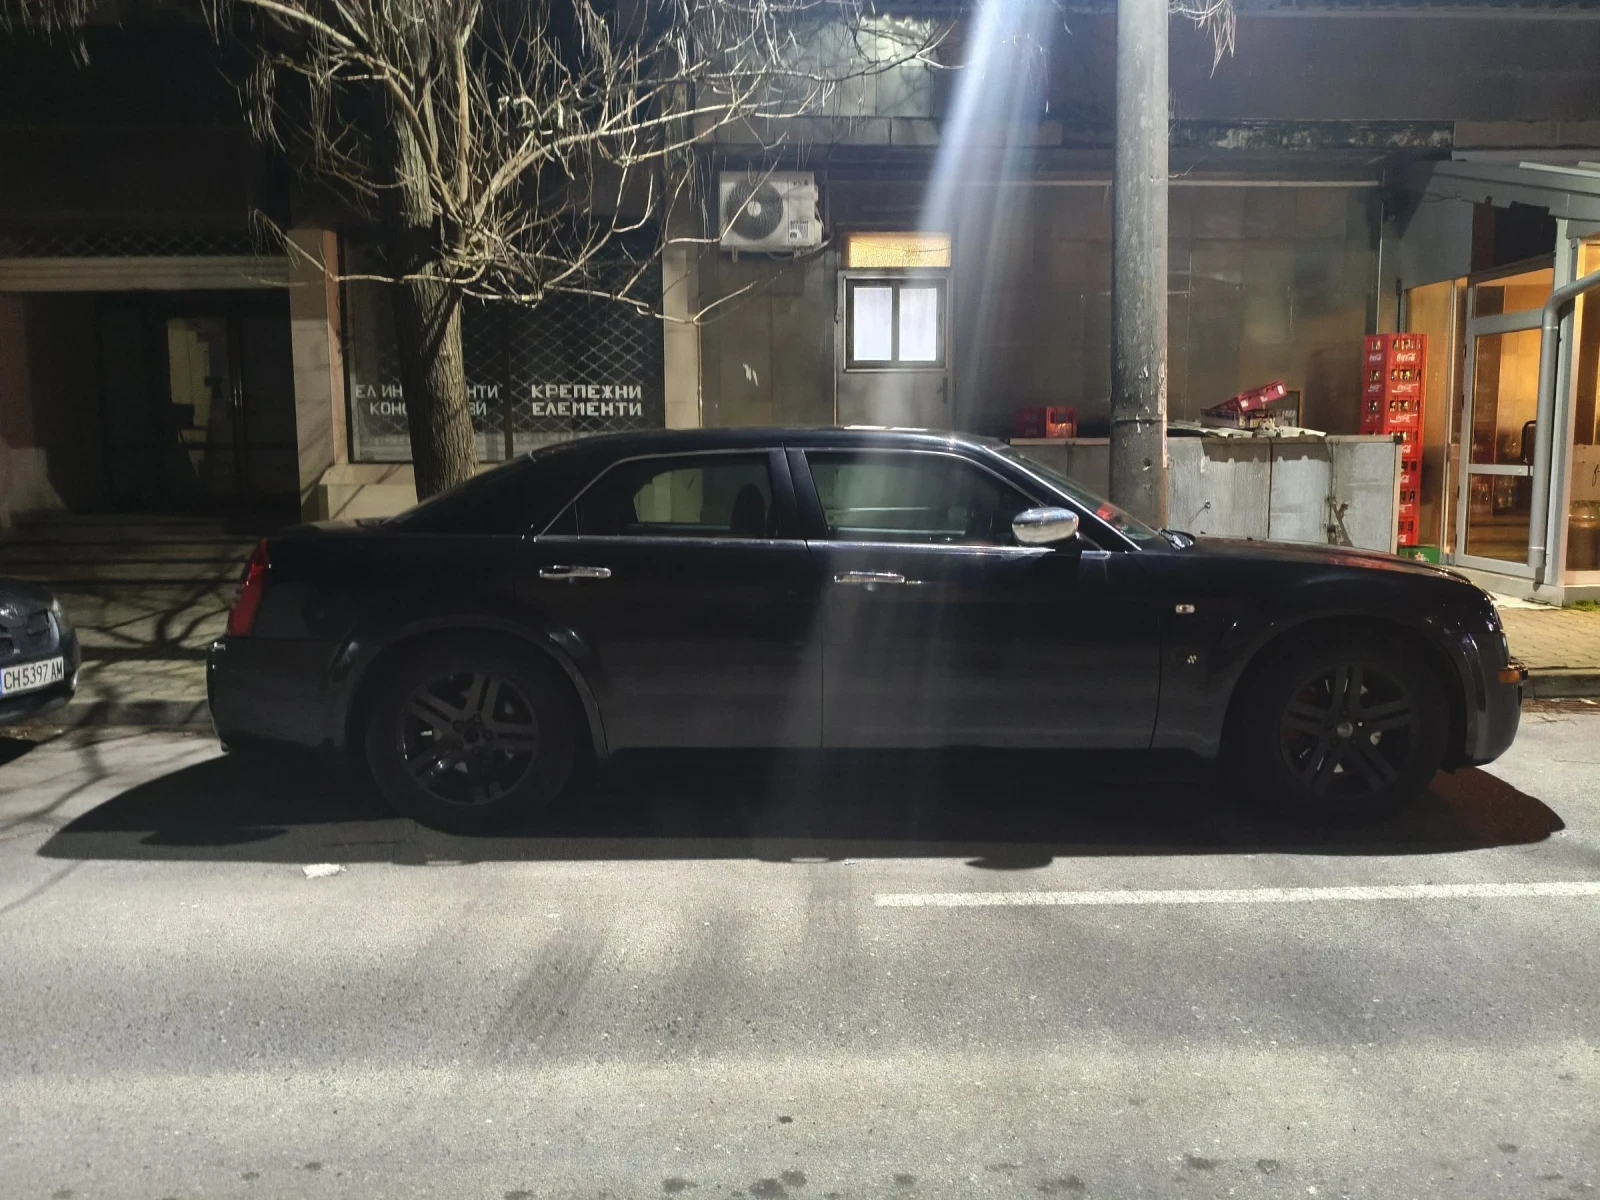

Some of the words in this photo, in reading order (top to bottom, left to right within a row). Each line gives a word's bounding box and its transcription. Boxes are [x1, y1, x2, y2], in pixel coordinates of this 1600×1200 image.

[355, 384, 377, 399] ЕЛ
[531, 384, 642, 399] КРЕПЕЖНИ
[532, 401, 642, 416] ЕЛЕМЕНТИ
